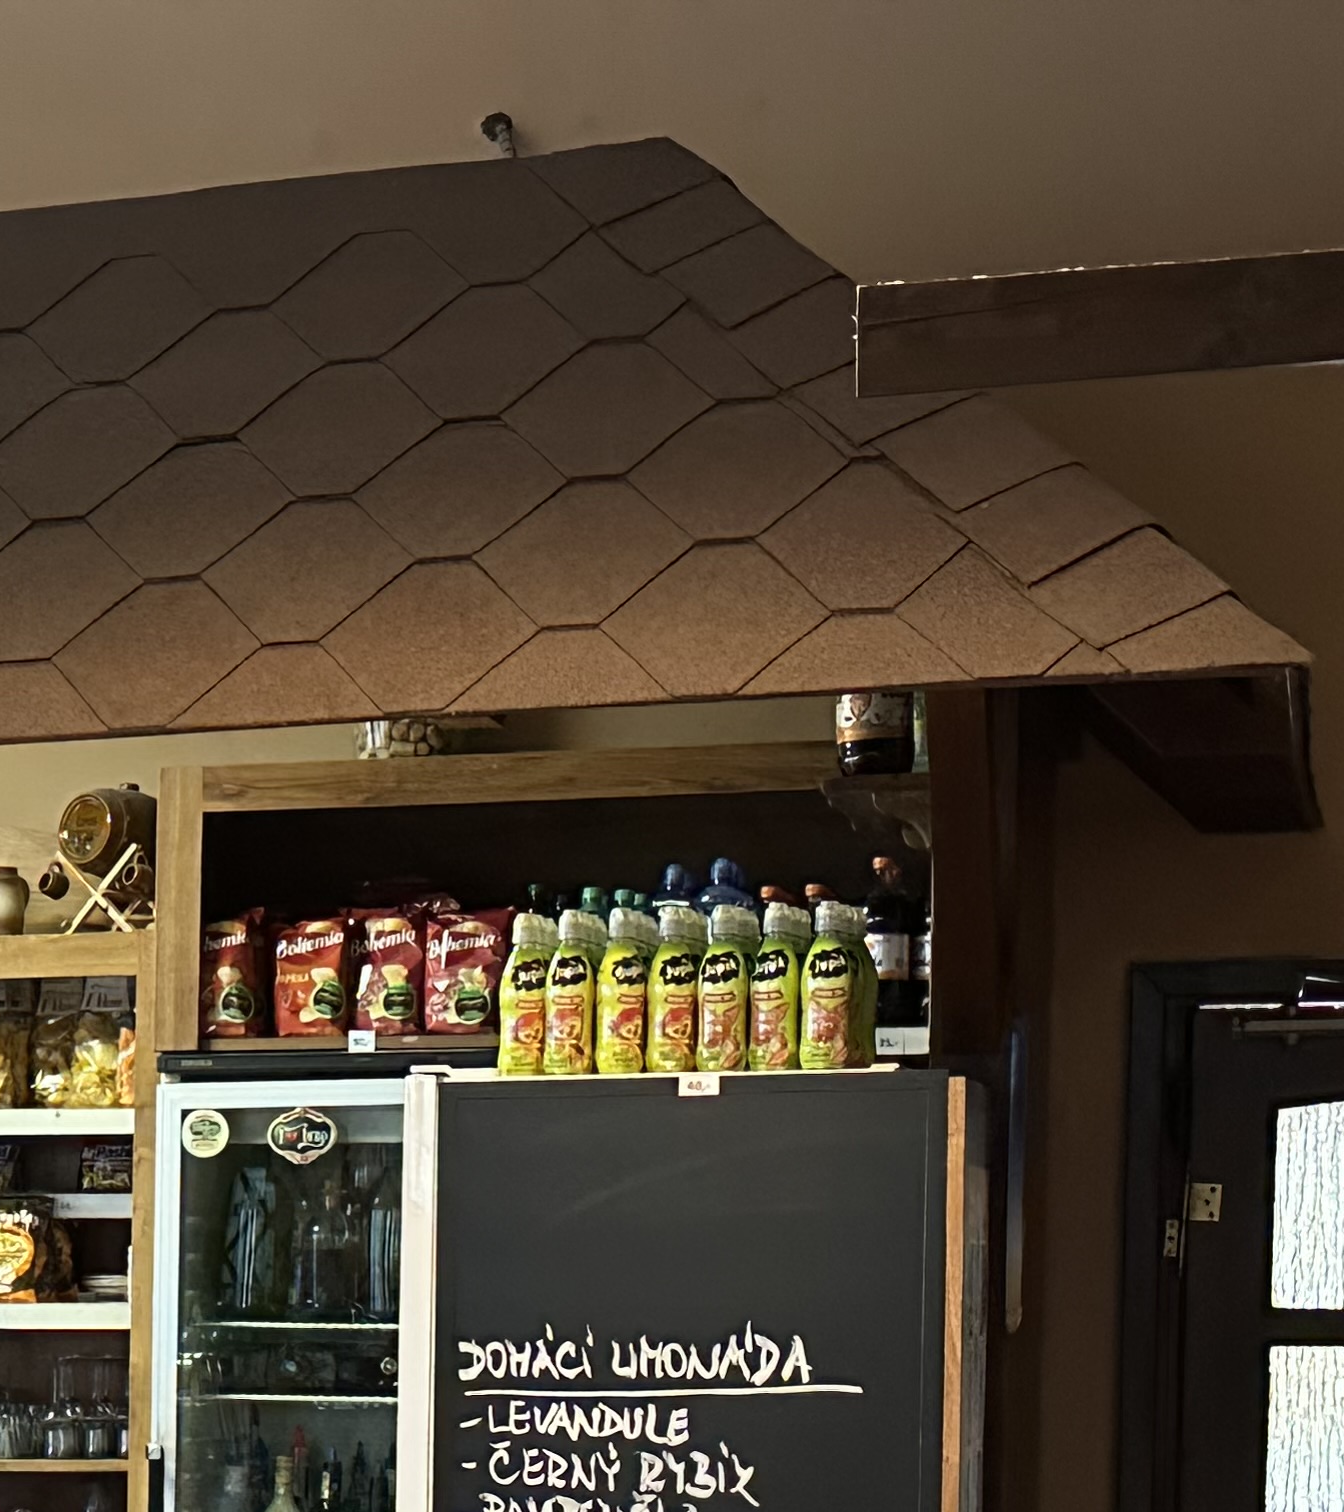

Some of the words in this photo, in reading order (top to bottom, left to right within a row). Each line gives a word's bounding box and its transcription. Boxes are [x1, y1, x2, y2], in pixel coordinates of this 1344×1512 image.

[276, 931, 344, 960] Bohemia
[458, 1323, 594, 1381] DOMÁCÍ
[612, 1321, 812, 1385] LIMONÁDA
[488, 1400, 690, 1444] LEVANDULE
[489, 1441, 621, 1492] ČERNÝ
[640, 1441, 760, 1507] RYBÍZ
